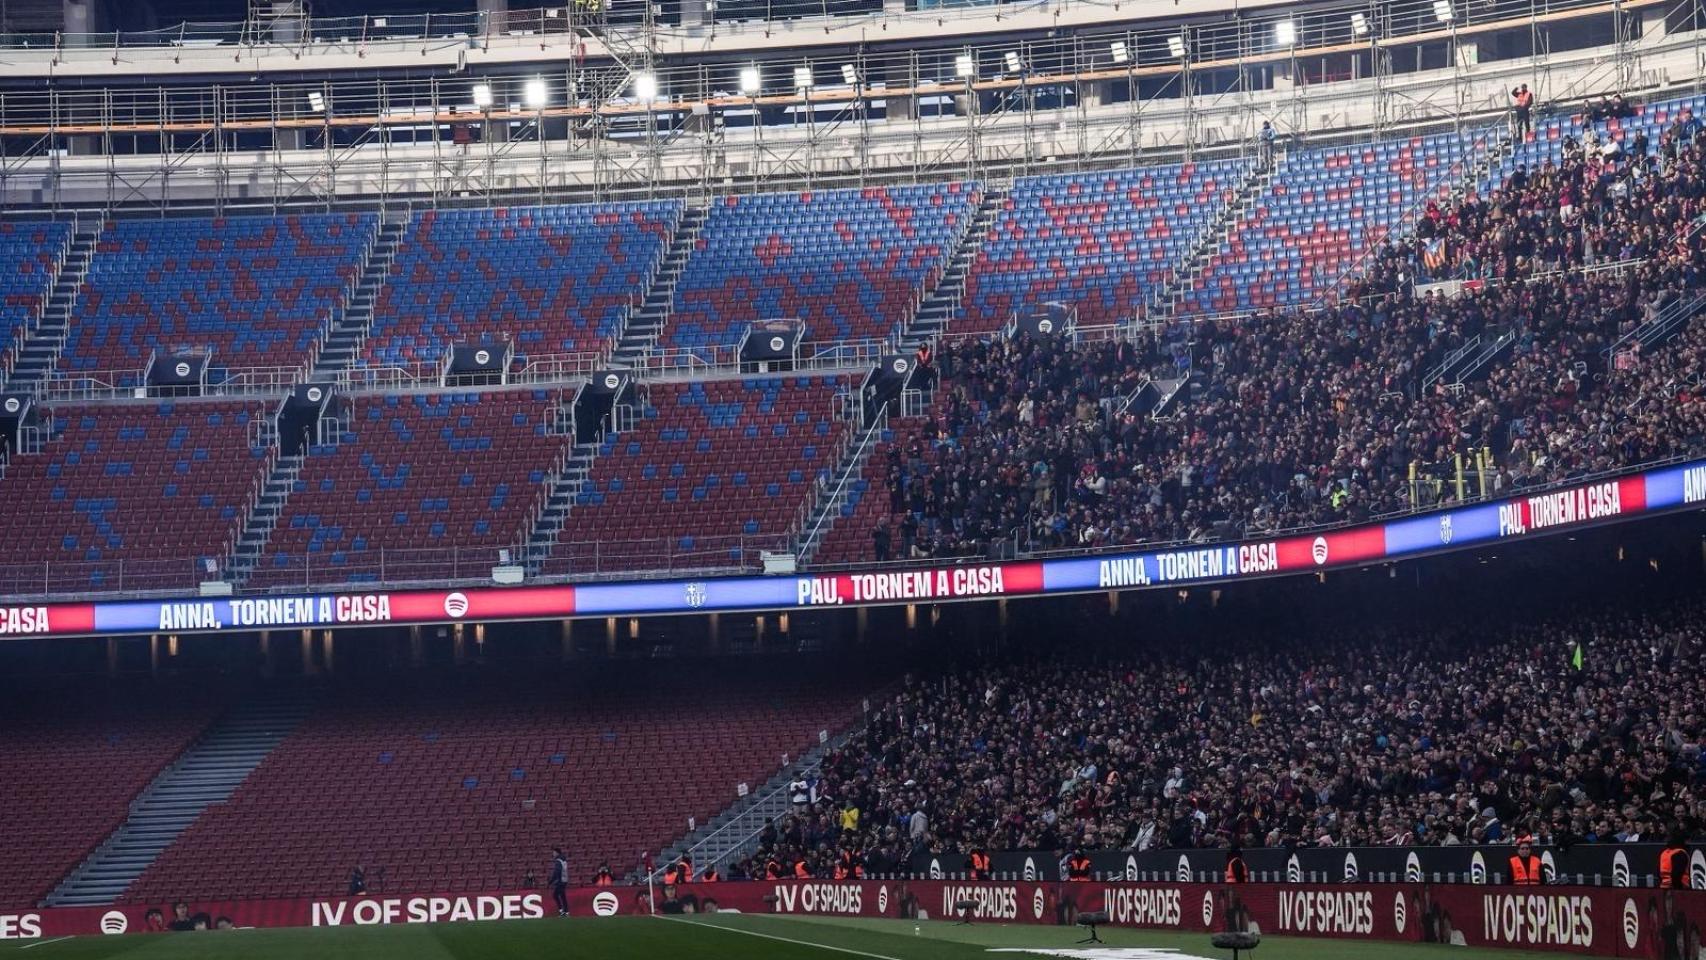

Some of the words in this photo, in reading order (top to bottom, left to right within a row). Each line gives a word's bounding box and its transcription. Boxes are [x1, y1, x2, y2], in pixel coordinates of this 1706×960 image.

[1499, 503, 1526, 536] PAU,
[1528, 490, 1577, 529] TORNEM
[1577, 488, 1587, 521] A
[1588, 481, 1621, 519] CASA
[1100, 557, 1151, 587] ANNA,
[1156, 548, 1223, 580] TORNEM
[1226, 547, 1237, 575] A
[1240, 542, 1278, 573] CASA
[798, 578, 844, 605] PAU,
[851, 571, 932, 600] TORNEM
[936, 570, 949, 596] A
[953, 567, 1004, 595] CASA
[0, 607, 49, 634] CASA
[160, 603, 221, 630] ANNA,
[229, 598, 314, 625] TORNEM
[319, 597, 333, 622] A
[336, 595, 391, 622] CASA
[312, 901, 347, 926] IV
[353, 899, 401, 925] OF
[407, 894, 544, 923] SPADES
[775, 884, 798, 912] IV
[801, 883, 820, 912] OF
[820, 883, 862, 914] SPADES
[943, 885, 955, 917] IV
[973, 886, 1017, 919] SPADES
[1104, 888, 1116, 922] IV
[1117, 887, 1133, 923] OF
[1134, 887, 1181, 925] SPADES
[1279, 890, 1294, 930] IV
[1295, 890, 1315, 932] OF
[1316, 890, 1373, 934] SPADES
[0, 913, 42, 939] ES
[1484, 895, 1500, 940] IV
[1503, 894, 1525, 943] OF
[1527, 894, 1593, 947] SPADES
